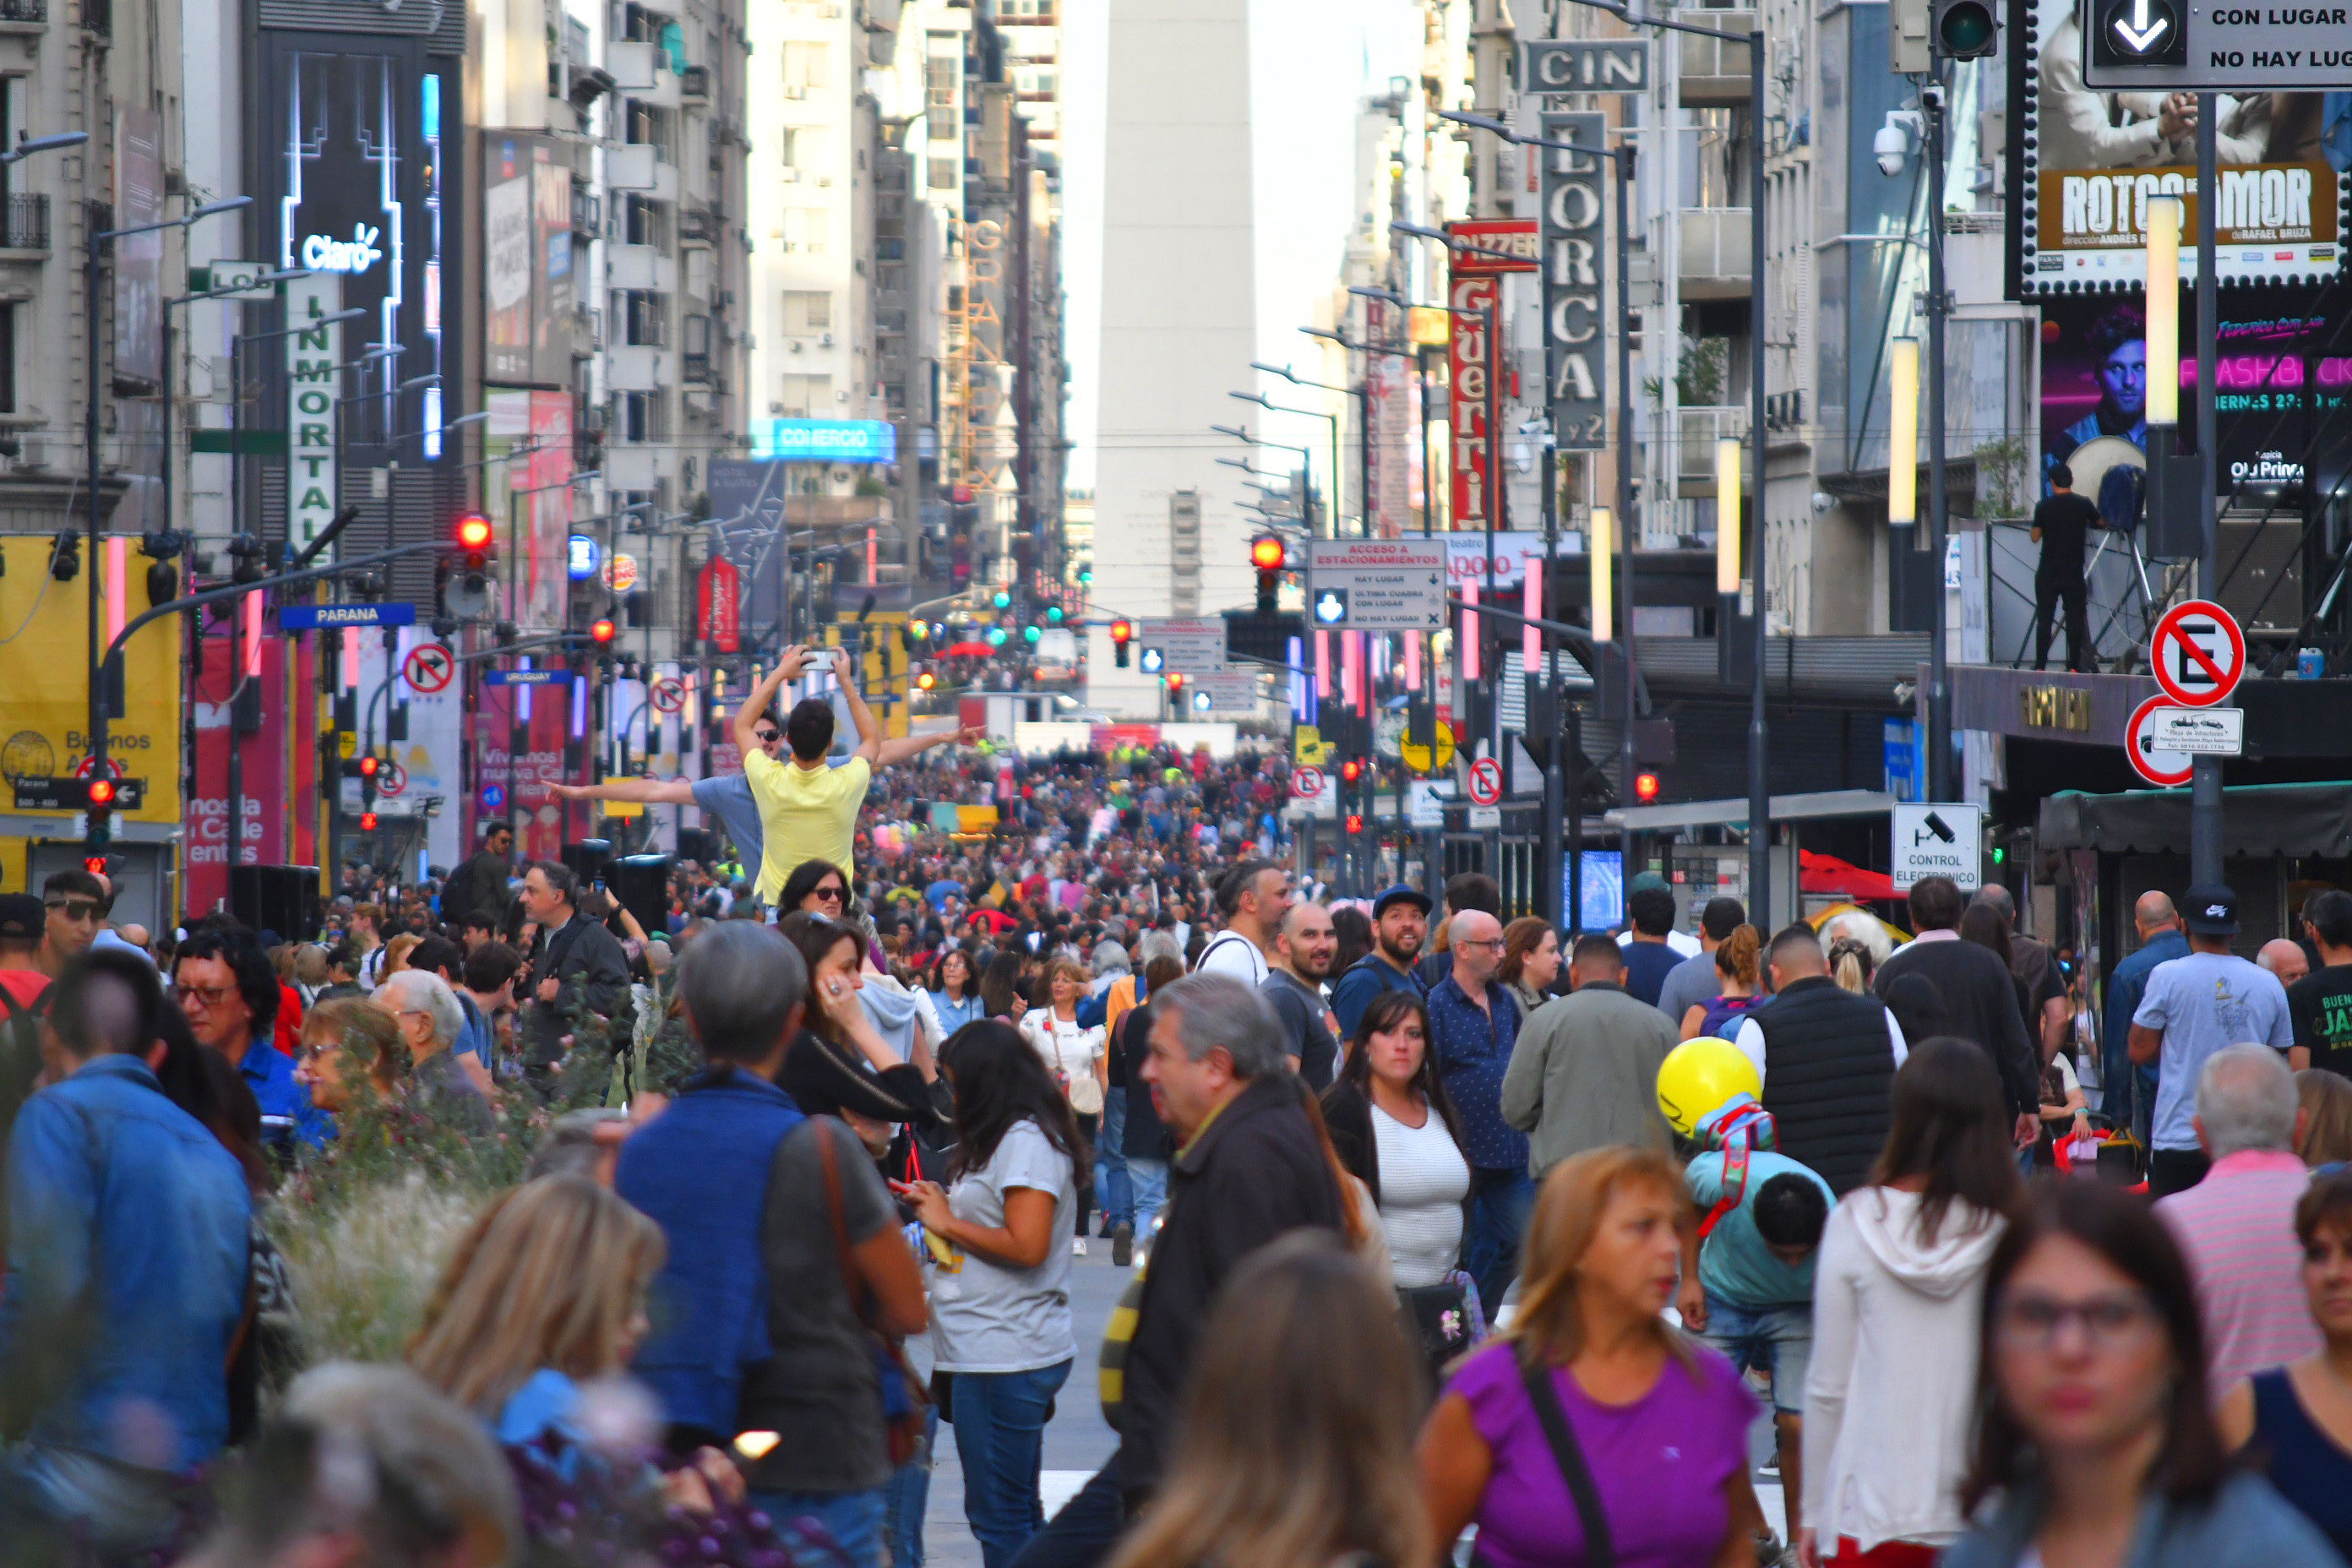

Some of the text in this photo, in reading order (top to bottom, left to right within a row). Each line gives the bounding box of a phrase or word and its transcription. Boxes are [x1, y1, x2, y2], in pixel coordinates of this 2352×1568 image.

[2212, 9, 2346, 24] CON LUGAR
[1540, 50, 1641, 84] CIN
[2210, 51, 2244, 68] NO
[2252, 51, 2301, 68] HAY
[2280, 227, 2311, 238] BRUZA
[302, 234, 370, 272] Claro
[1549, 125, 1600, 400] LORCA
[781, 427, 868, 448] COMERCIO
[1349, 545, 1408, 553] ACCESO A
[1450, 538, 1484, 548] teatro
[1317, 555, 1439, 564] ESTACIONAMIENTOS
[317, 607, 378, 622] PARANA
[507, 672, 551, 681] URUGUAY
[1908, 854, 1963, 866] CONTROL
